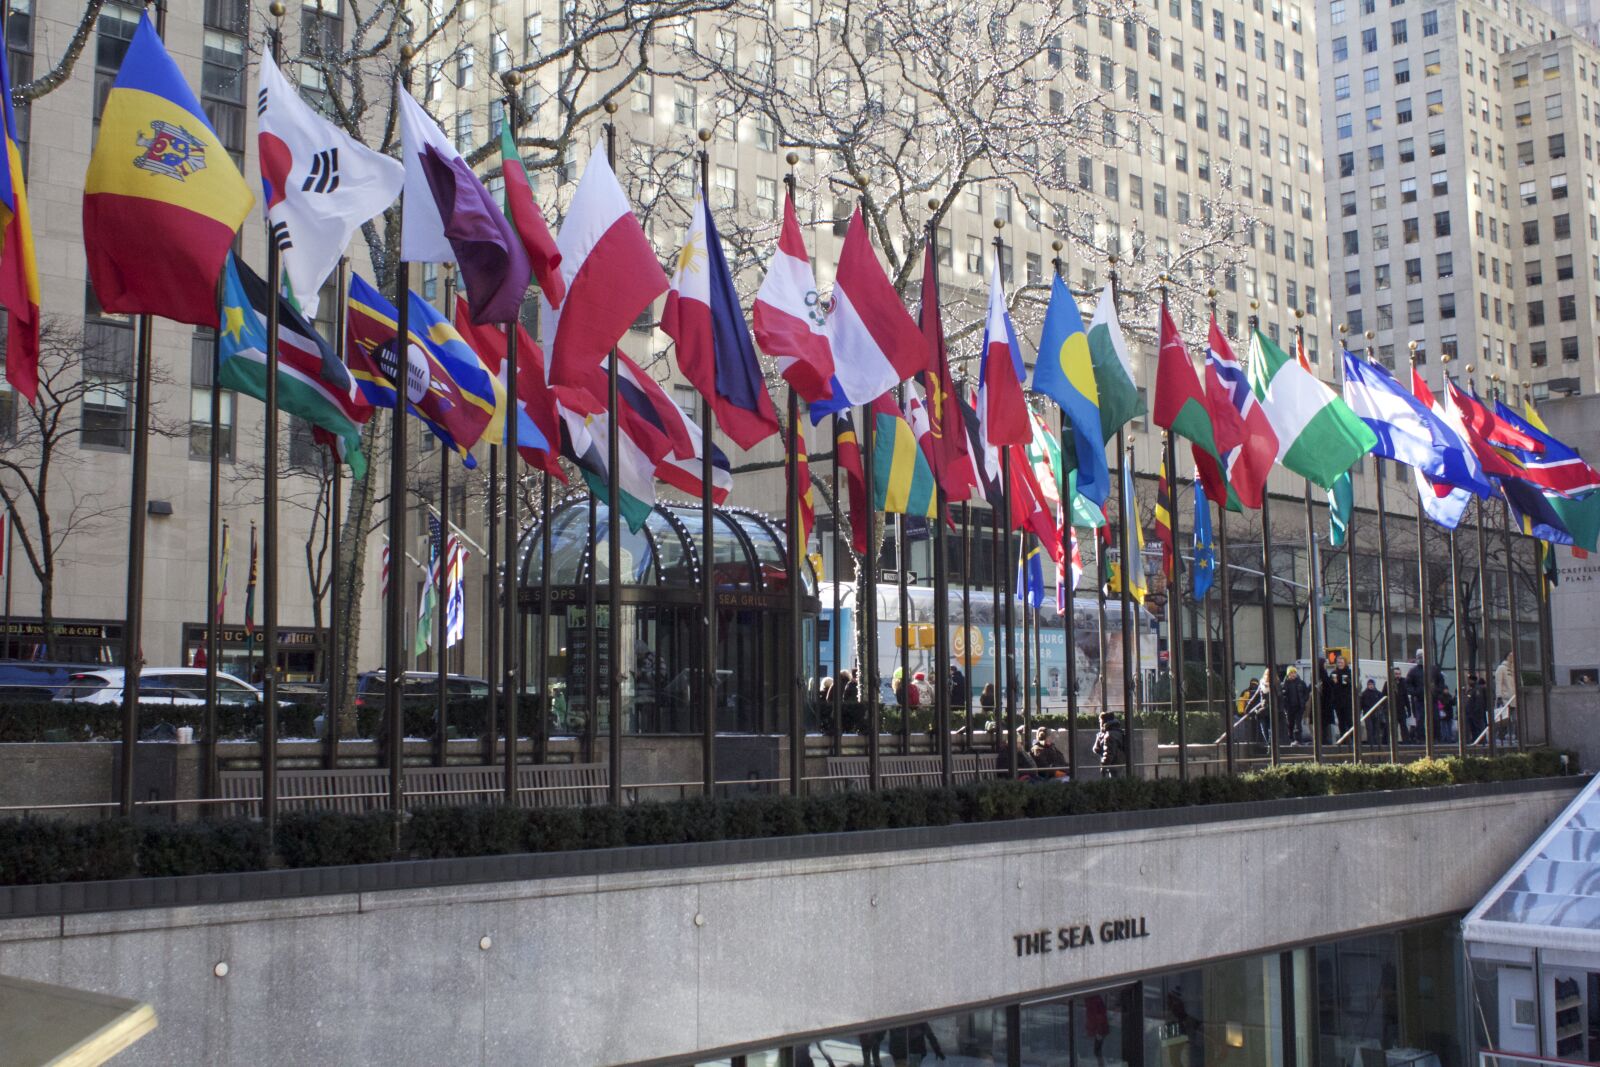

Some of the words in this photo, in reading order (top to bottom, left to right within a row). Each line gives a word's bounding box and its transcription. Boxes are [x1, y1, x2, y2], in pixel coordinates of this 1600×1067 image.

[534, 589, 576, 601] SOPS
[719, 594, 737, 605] SEA
[741, 595, 768, 606] GRILL
[1013, 928, 1052, 957] THE
[1058, 924, 1095, 950] SEA
[1100, 917, 1150, 943] GRILL
